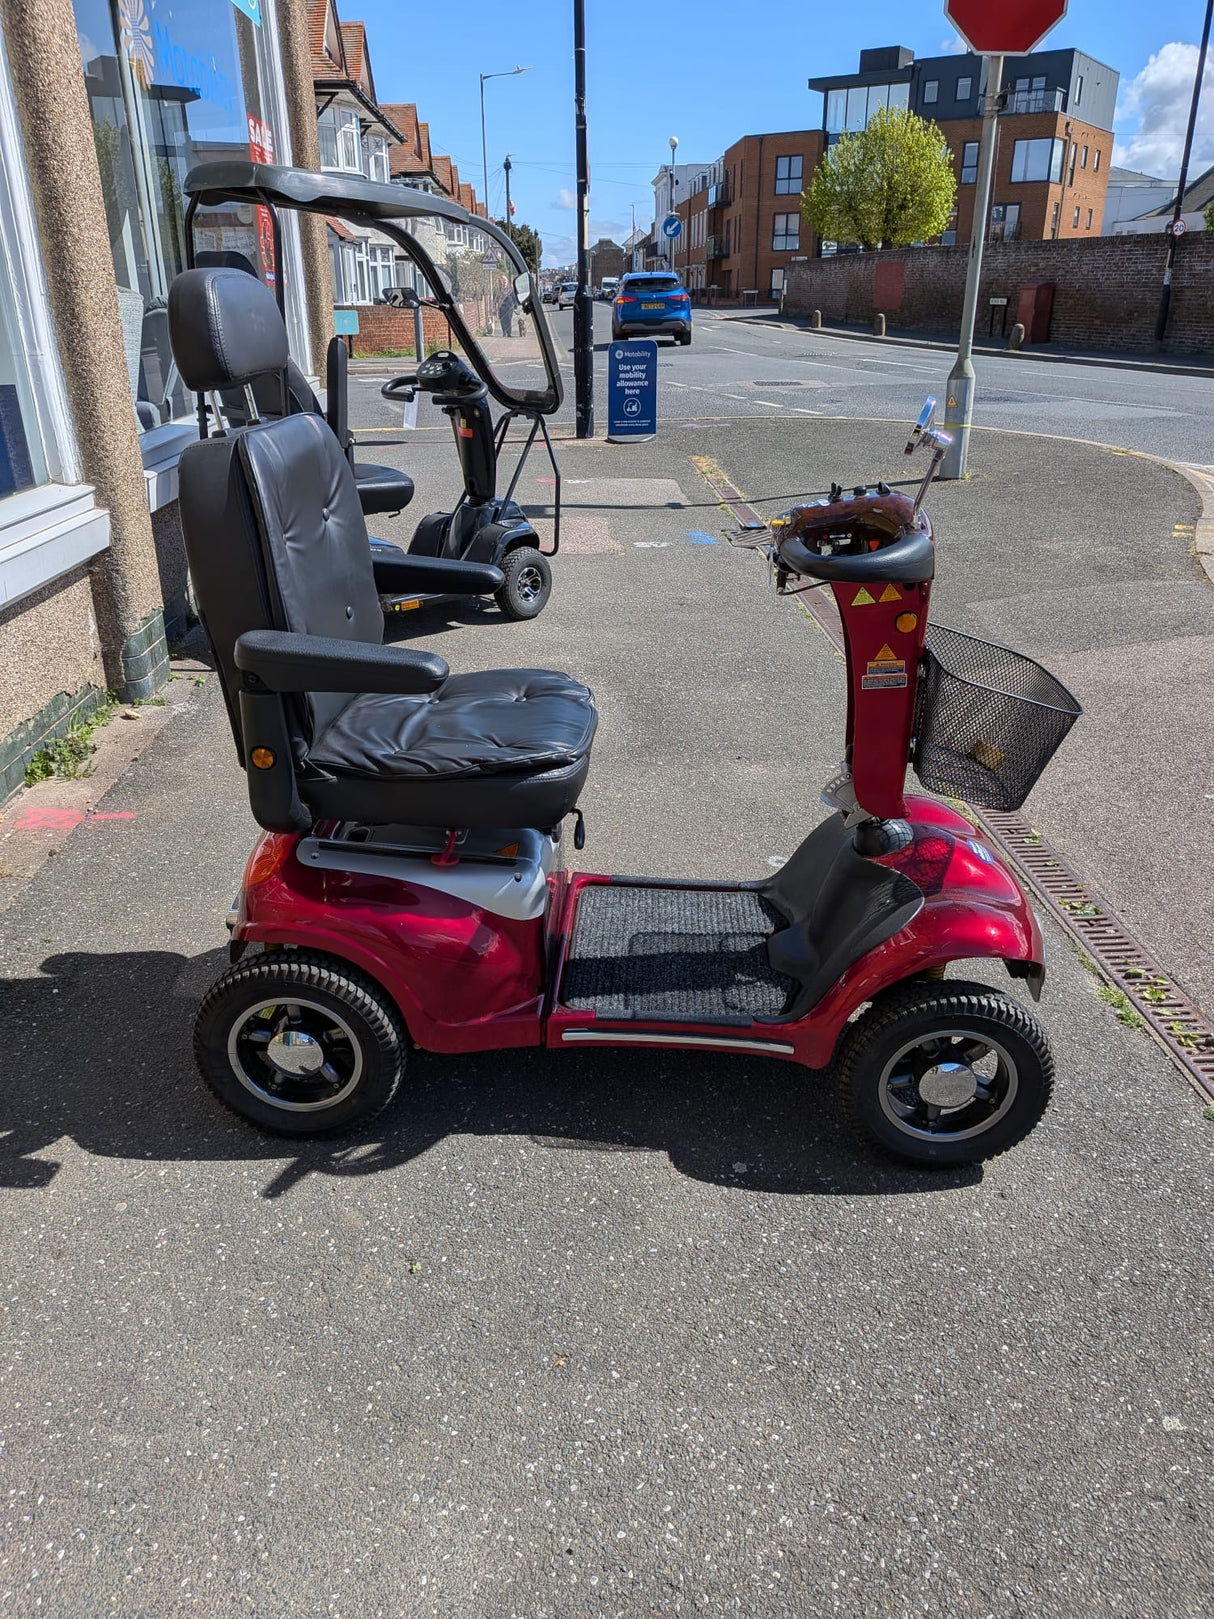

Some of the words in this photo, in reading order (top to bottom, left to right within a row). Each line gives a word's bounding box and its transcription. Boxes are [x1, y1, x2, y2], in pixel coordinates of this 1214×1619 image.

[248, 118, 274, 153] SALE
[1174, 224, 1184, 232] 20
[618, 363, 631, 371] Use
[631, 364, 647, 372] your
[619, 371, 647, 380] mobility
[624, 387, 640, 395] here
